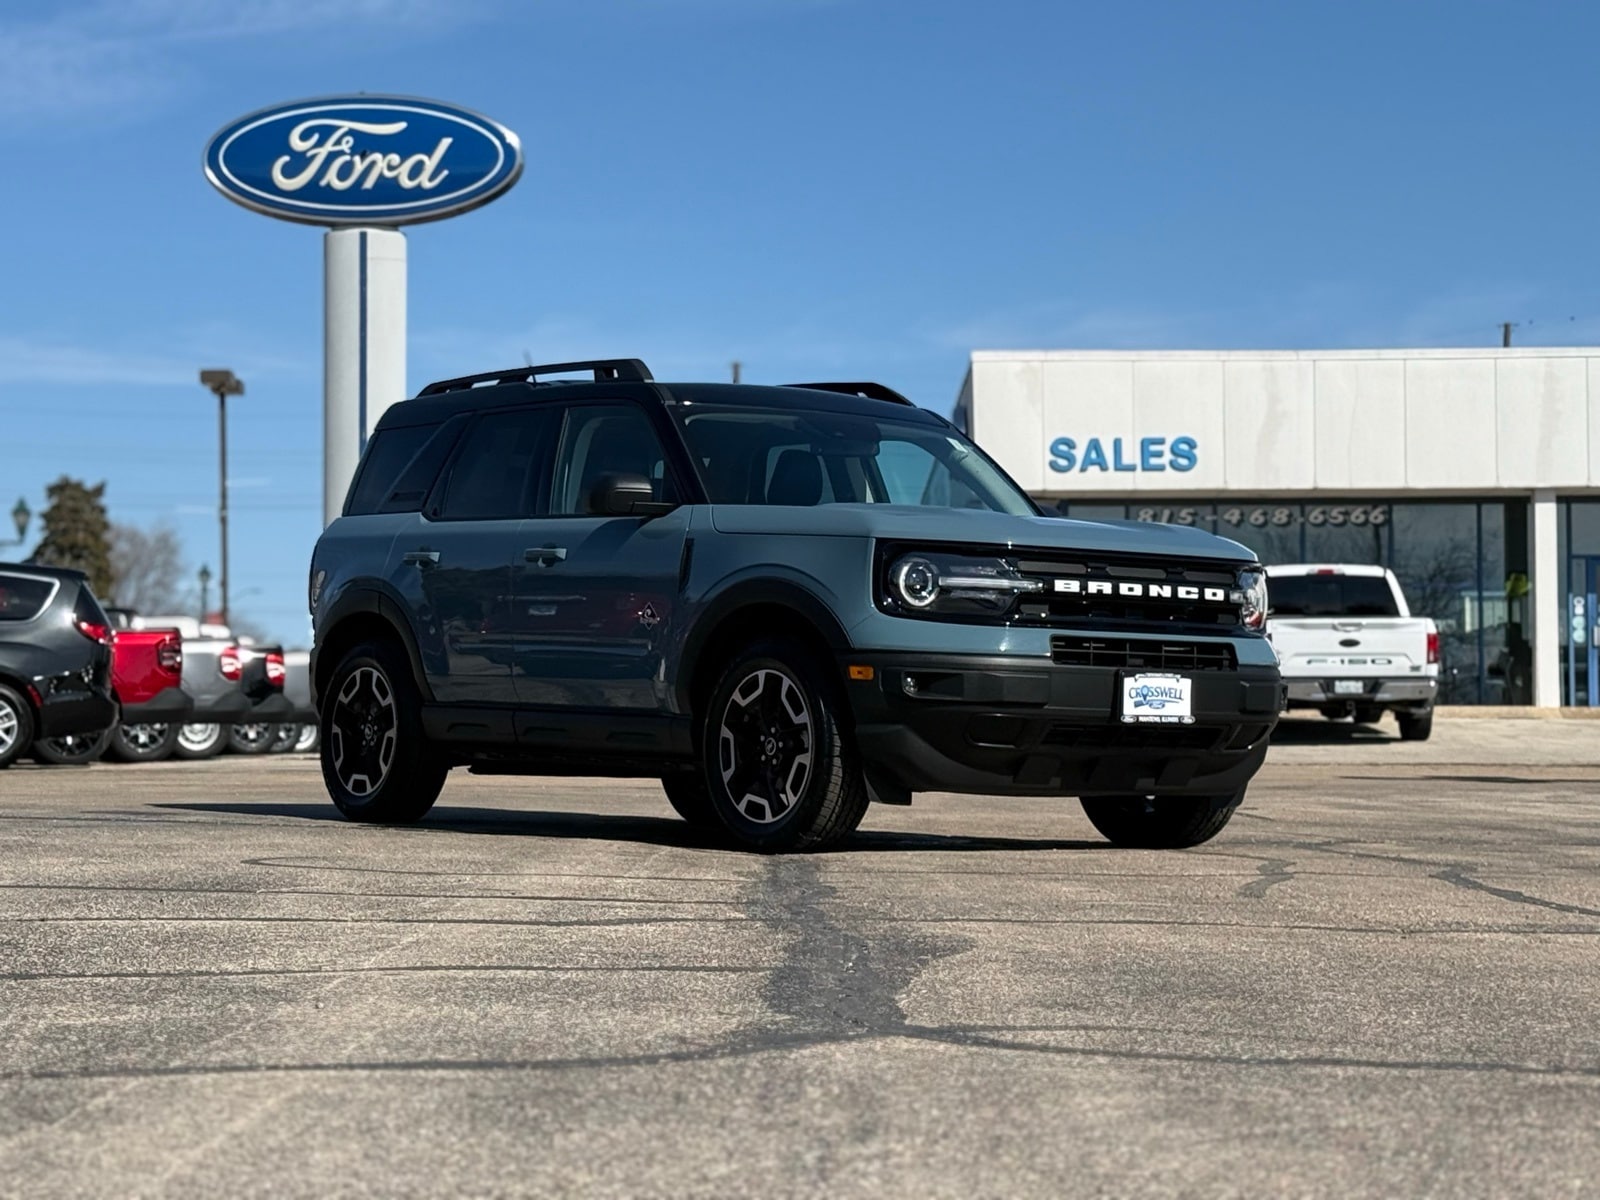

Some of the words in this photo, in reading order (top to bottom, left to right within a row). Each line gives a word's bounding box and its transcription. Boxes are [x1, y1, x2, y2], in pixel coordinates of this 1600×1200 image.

[271, 118, 453, 191] Ford
[1049, 436, 1198, 473] SALES
[1054, 579, 1225, 601] BRONCO
[1128, 685, 1185, 701] CROSSWELL
